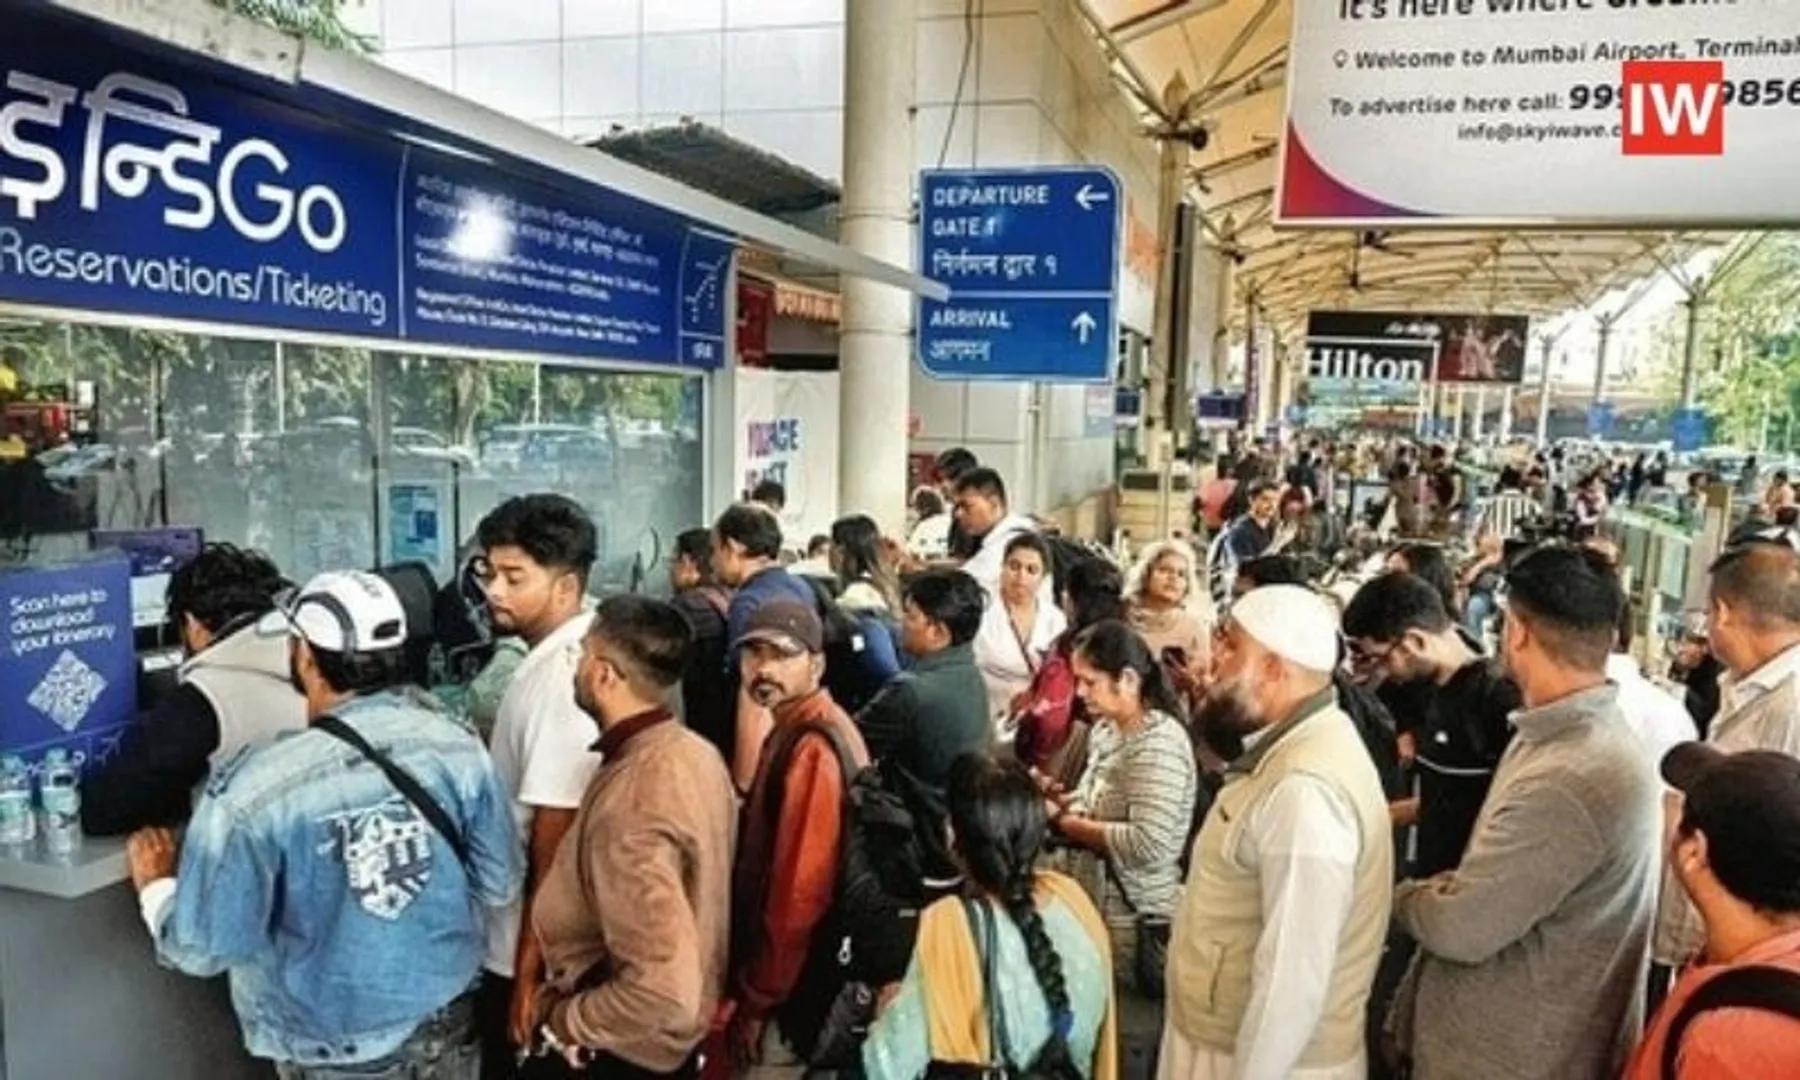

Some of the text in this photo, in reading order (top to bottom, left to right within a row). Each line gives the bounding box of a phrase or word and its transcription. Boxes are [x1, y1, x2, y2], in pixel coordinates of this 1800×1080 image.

[1356, 50, 1456, 69] Welcome
[1462, 50, 1486, 66] to
[1492, 43, 1586, 65] Mumbai
[1694, 33, 1800, 57] Terminal
[1331, 97, 1353, 116] To
[1359, 96, 1456, 116] advertise
[1463, 94, 1511, 113] here
[933, 185, 1050, 207] DEPARTURE
[0, 227, 387, 326] Reservations/Ticketing
[929, 309, 1014, 329] ARRIVAL
[1304, 347, 1424, 379] Hilton
[10, 596, 51, 616] Scan
